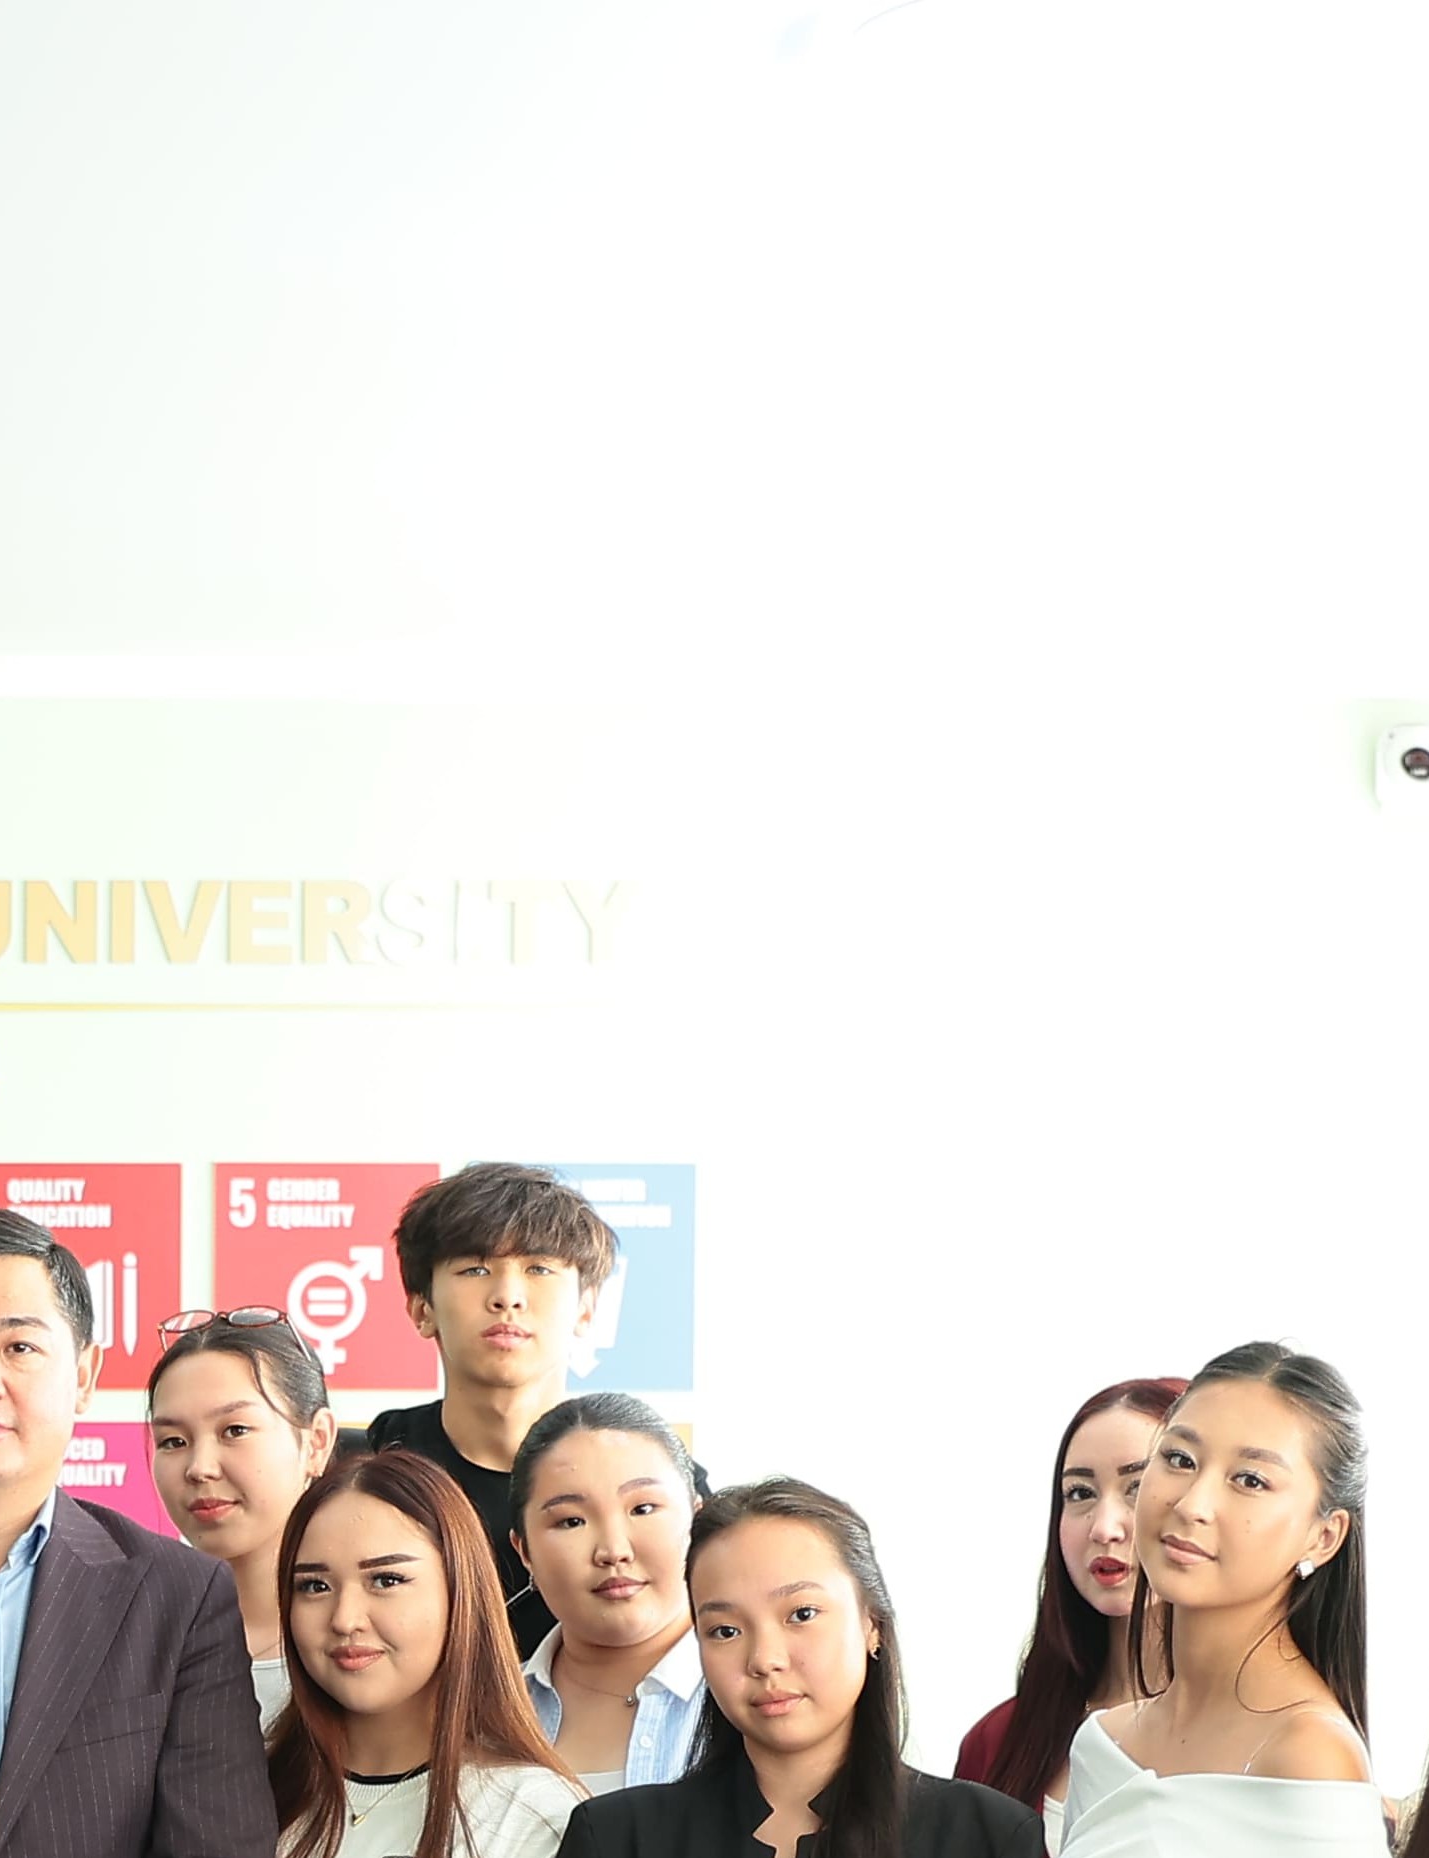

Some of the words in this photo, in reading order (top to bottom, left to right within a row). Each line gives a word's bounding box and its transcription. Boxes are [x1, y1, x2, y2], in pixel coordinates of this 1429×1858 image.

[6, 1178, 86, 1204] QUALITY
[228, 1177, 257, 1228] 5
[266, 1178, 340, 1202] GENDER
[266, 1204, 356, 1229] EQUALITY
[59, 1463, 127, 1487] UALITY
